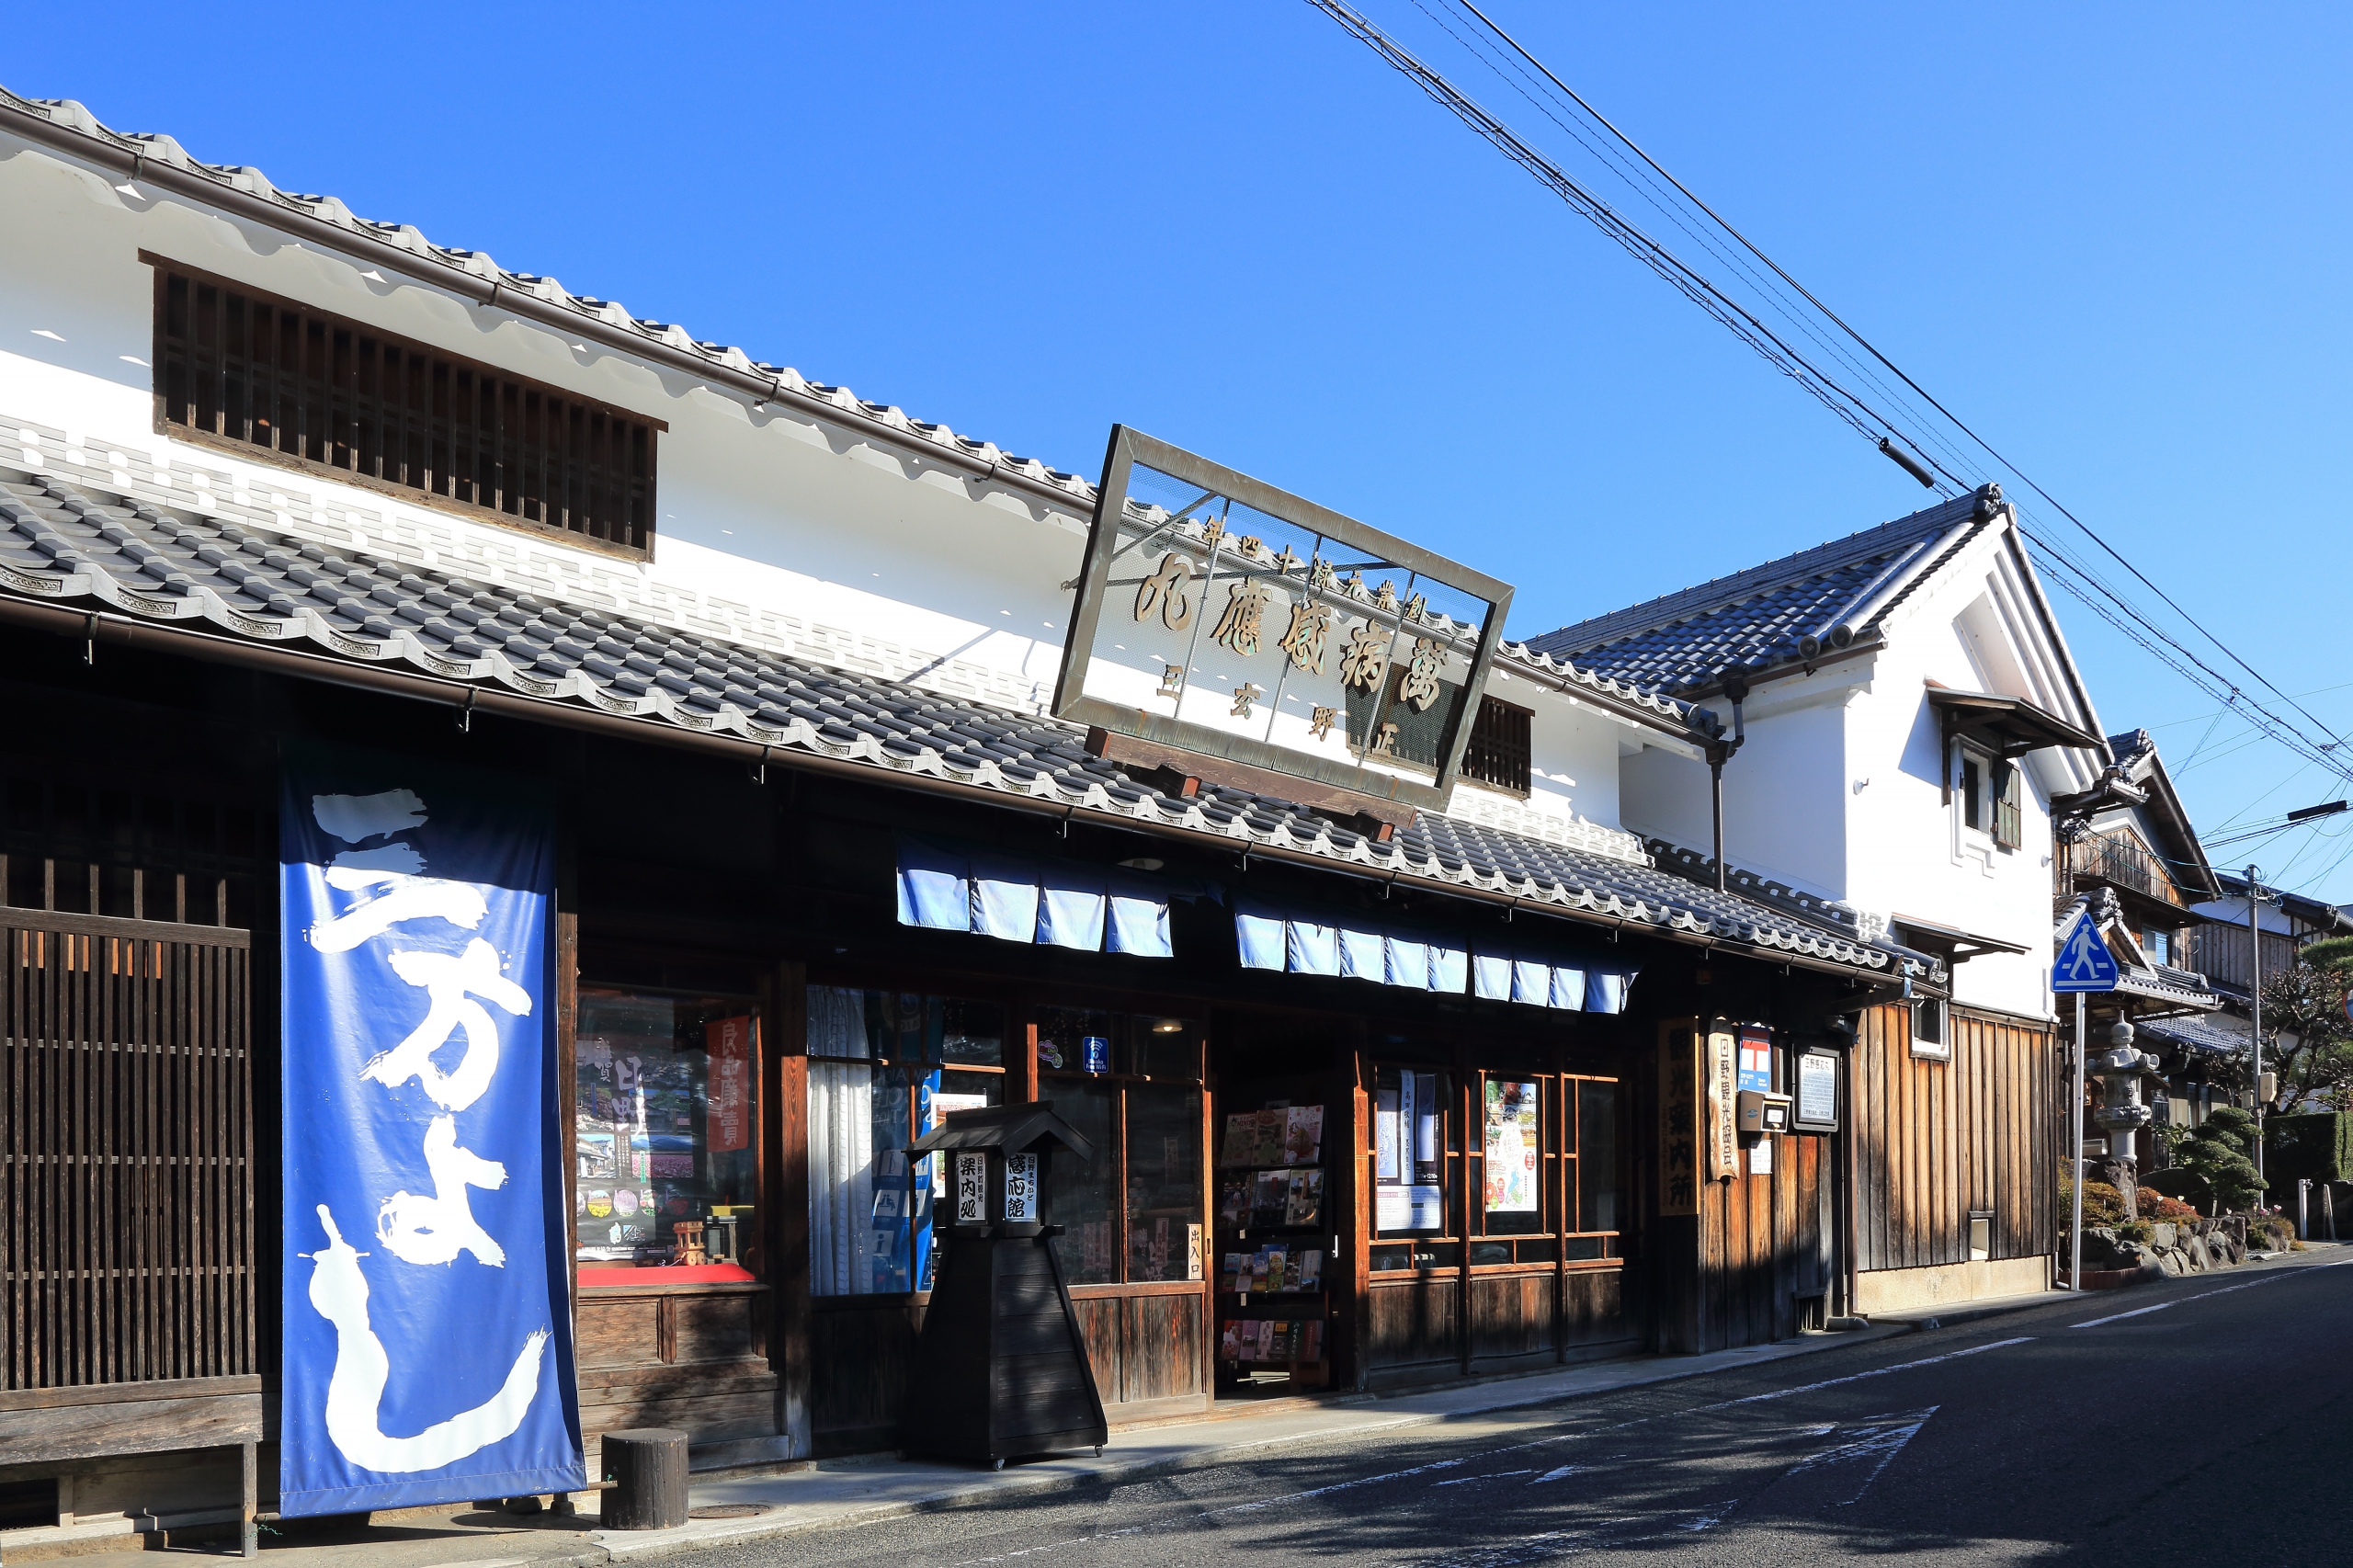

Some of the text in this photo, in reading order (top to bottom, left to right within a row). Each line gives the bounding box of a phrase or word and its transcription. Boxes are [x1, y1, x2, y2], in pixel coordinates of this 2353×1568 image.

[298, 788, 551, 1472] 三方よし
[960, 1155, 976, 1219] 案内処
[1007, 1154, 1026, 1218] 感応館
[1189, 1230, 1200, 1274] 出入口
